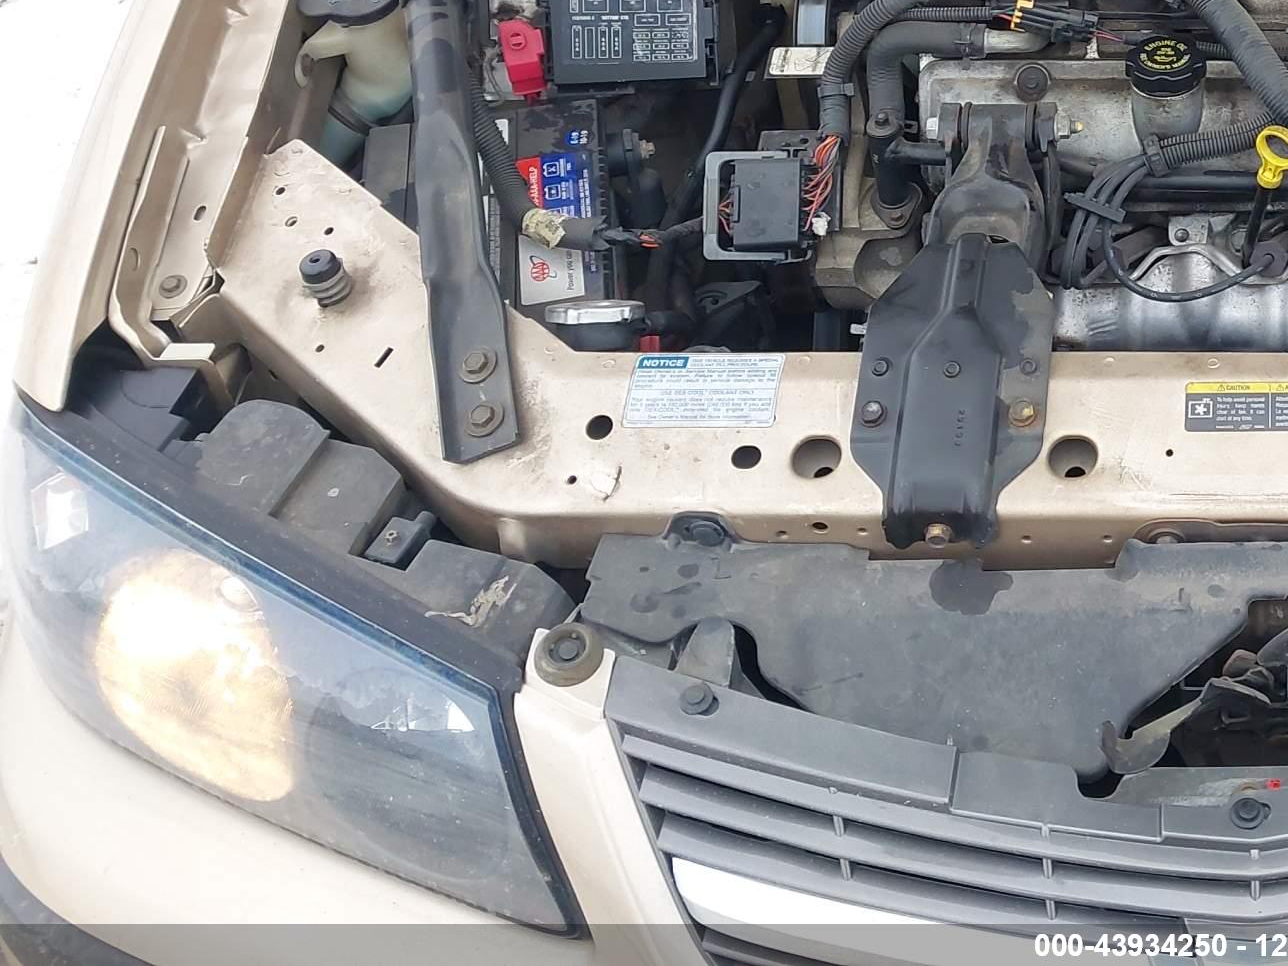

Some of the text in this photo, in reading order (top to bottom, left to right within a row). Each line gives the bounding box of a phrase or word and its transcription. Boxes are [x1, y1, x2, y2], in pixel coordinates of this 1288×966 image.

[1143, 39, 1177, 51] ENGINE
[565, 272, 575, 291] Power
[642, 359, 685, 367] NOTICE
